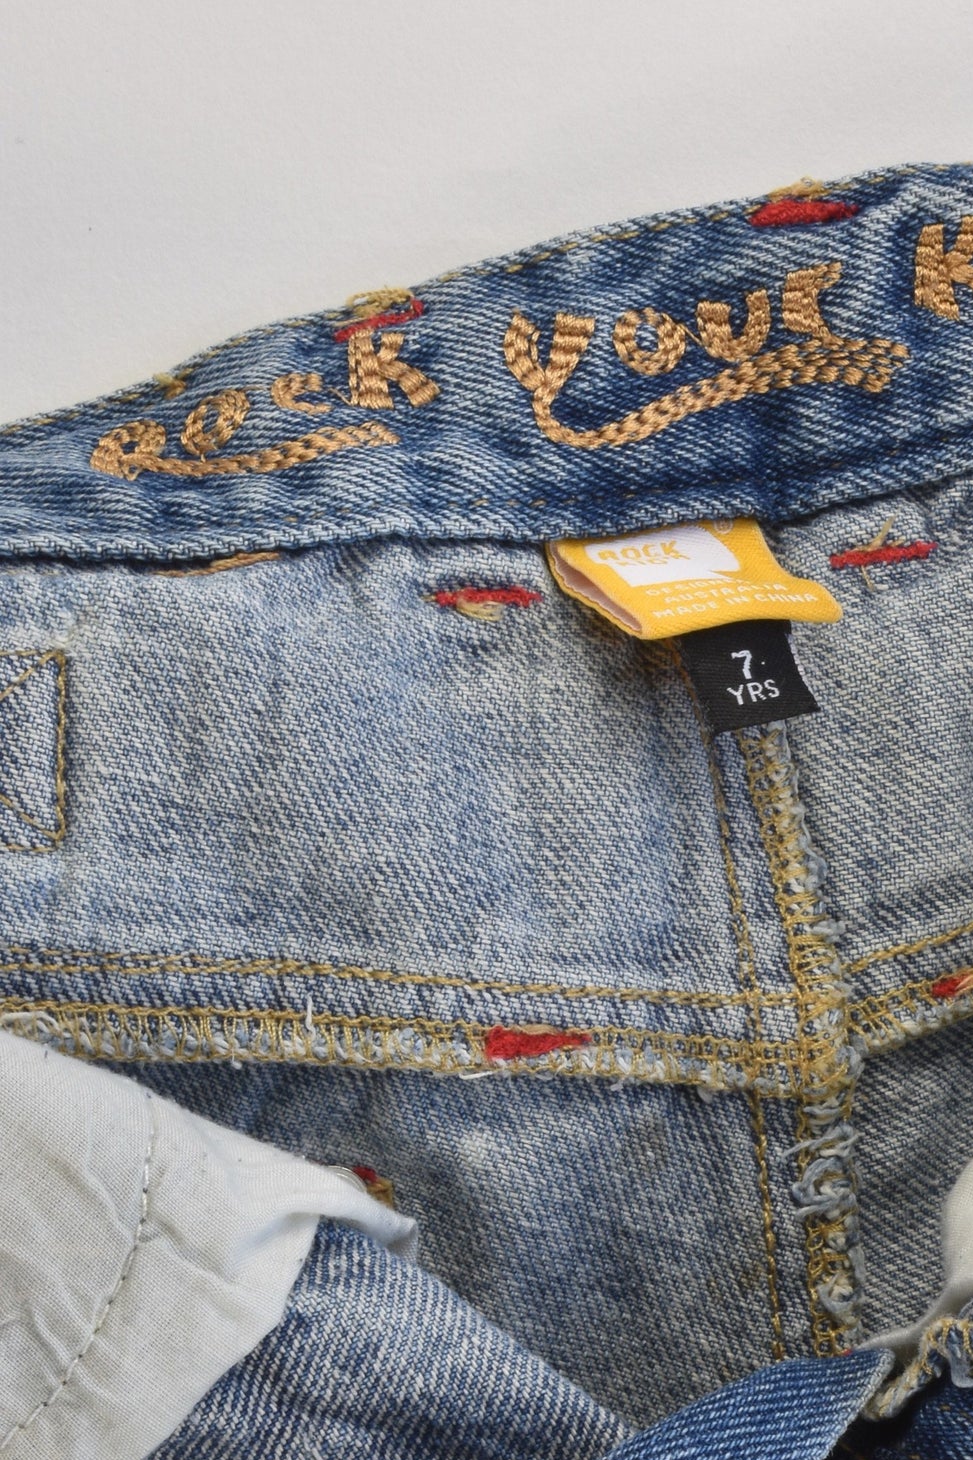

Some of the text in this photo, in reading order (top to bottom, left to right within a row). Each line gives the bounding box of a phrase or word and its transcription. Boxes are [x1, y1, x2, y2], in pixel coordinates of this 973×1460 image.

[597, 539, 681, 562] ROCK
[651, 593, 818, 618] MADE IN CHINA
[663, 582, 788, 604] AUSTRALIA
[730, 649, 753, 680] 7
[726, 679, 781, 706] YRS
